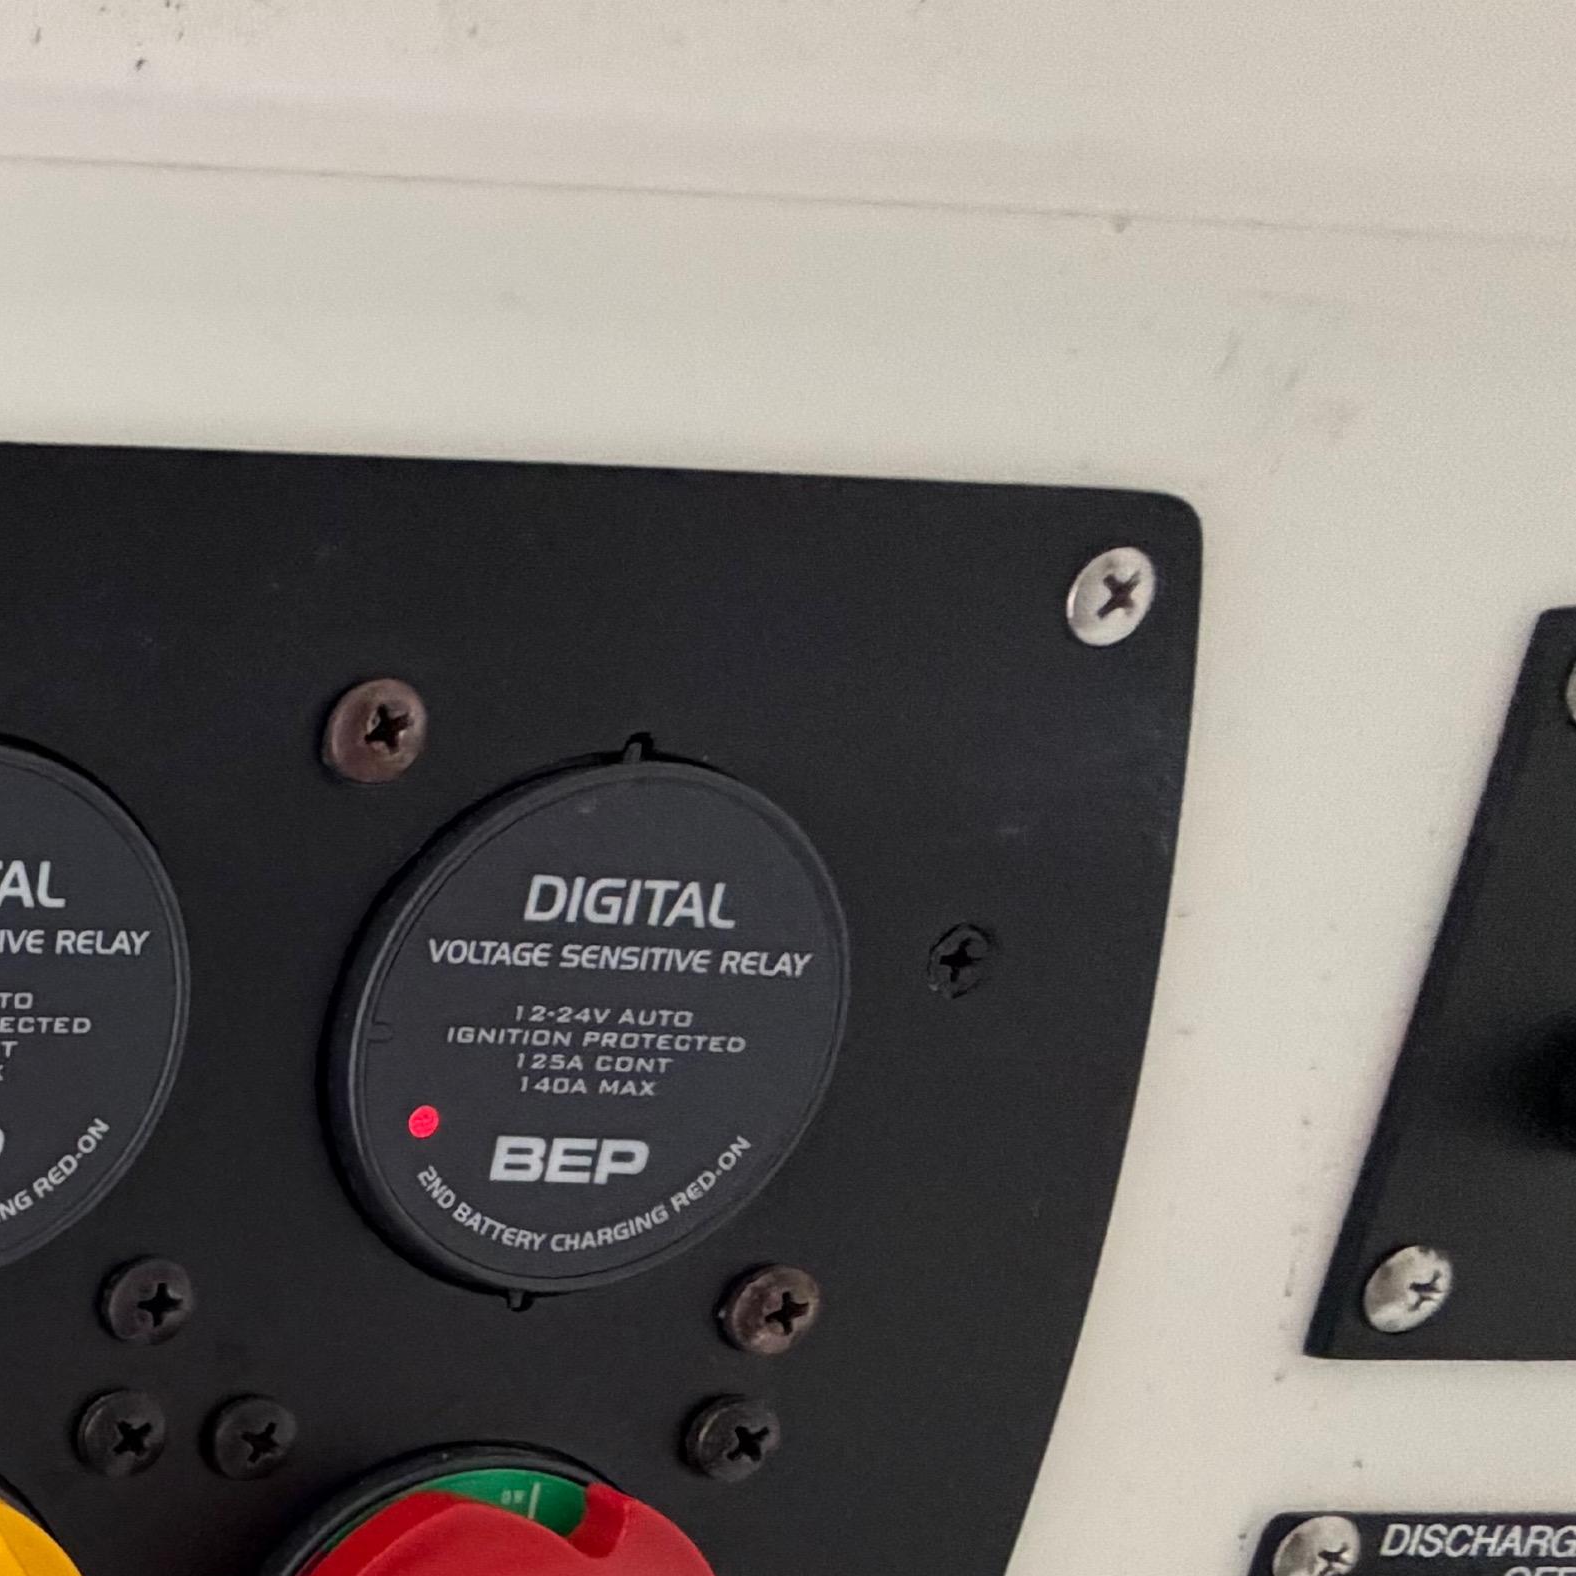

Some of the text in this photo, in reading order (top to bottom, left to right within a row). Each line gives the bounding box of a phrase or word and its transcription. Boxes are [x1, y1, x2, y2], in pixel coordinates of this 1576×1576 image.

[524, 874, 736, 930] DIGITAL
[54, 929, 151, 956] RELAY
[428, 938, 813, 978] VOLTAGE SENSITIVE RELAY
[617, 1009, 694, 1028] AUTO
[447, 1026, 747, 1053] IGNITION PROTECTED
[516, 1053, 674, 1074] 125A CONT
[520, 1076, 657, 1097] 140A MAX
[32, 1117, 111, 1198] RED-ON
[489, 1135, 650, 1185] BEP
[416, 1164, 456, 1210] 2ND
[452, 1202, 547, 1251] BATTERY
[550, 1204, 669, 1253] CHARGING
